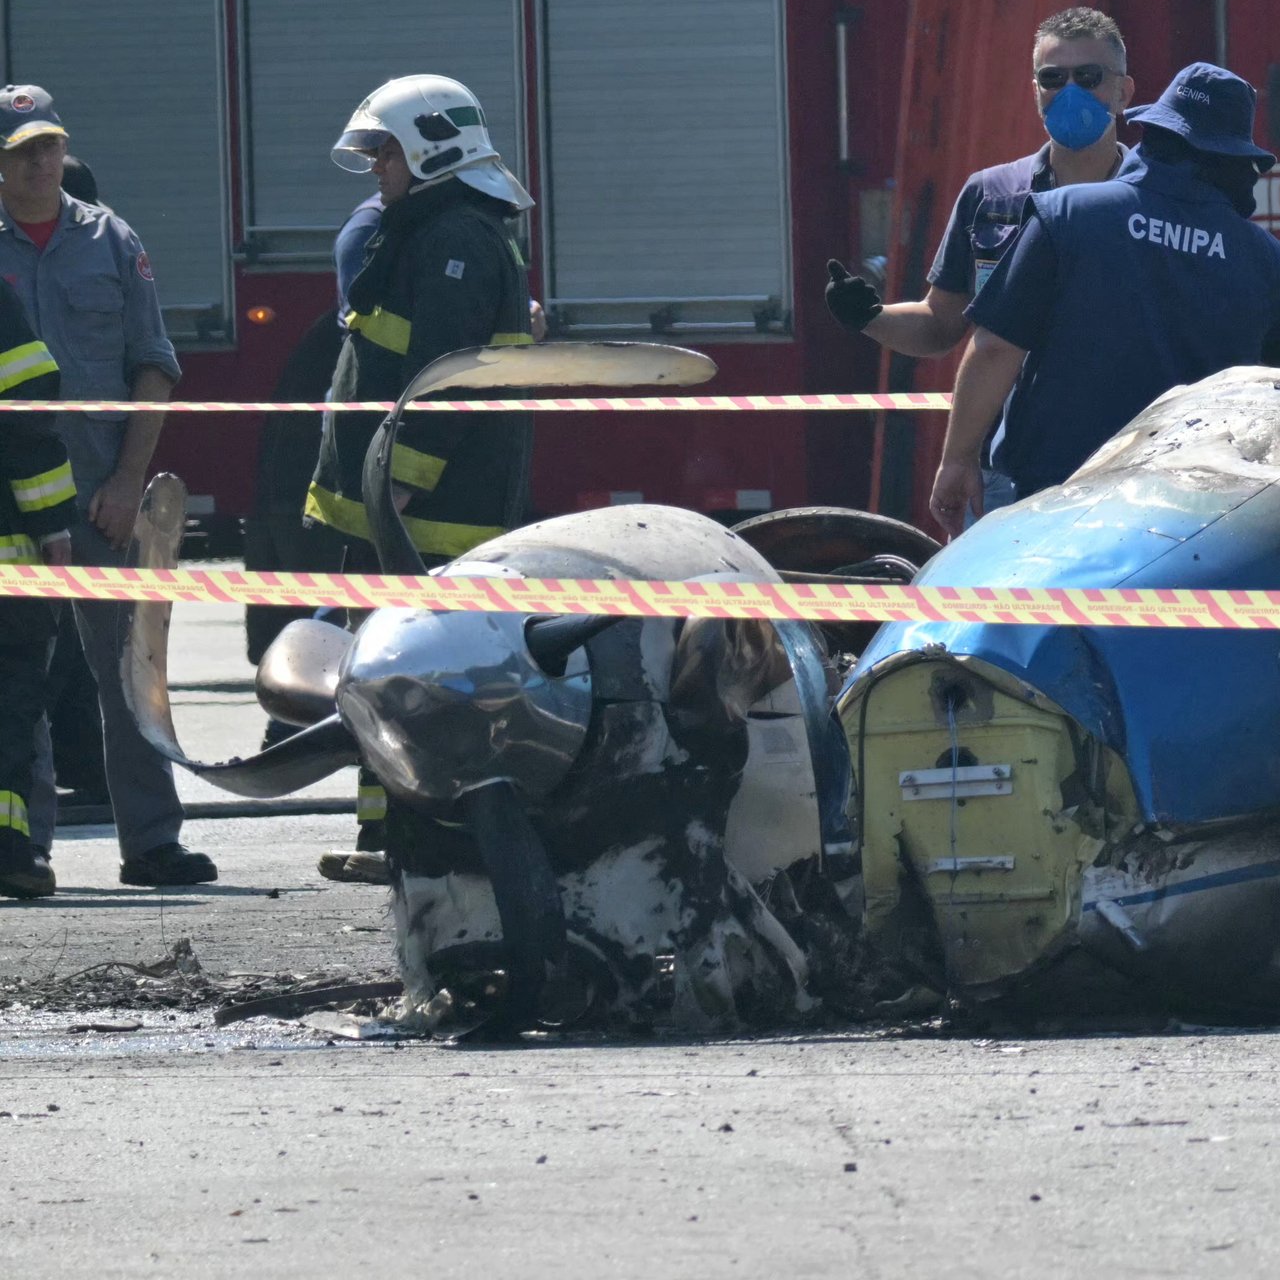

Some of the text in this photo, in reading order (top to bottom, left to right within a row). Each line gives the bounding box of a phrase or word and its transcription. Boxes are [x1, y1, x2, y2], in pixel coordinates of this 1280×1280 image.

[1176, 84, 1210, 105] CENIPA
[1128, 212, 1226, 260] CENIPA
[230, 586, 275, 595] BOMBEIROS
[297, 588, 345, 596] ULTRAPASSE
[370, 590, 416, 598] BOMBEIROS
[437, 591, 486, 600] ULTRAPASSE
[511, 593, 557, 602] BOMBEIROS
[579, 594, 628, 603] ULTRAPASSE
[653, 596, 700, 605] BOMBEIROS
[722, 598, 772, 607] ULTRAPASSE
[798, 600, 916, 610] BOMBEIROS NÃO ULTRAPASSE
[942, 602, 1061, 612] BOMBEIROS NÃO ULTRAPASSE
[1087, 604, 1134, 613] BOMBEIROS
[1140, 605, 1156, 613] NÃO
